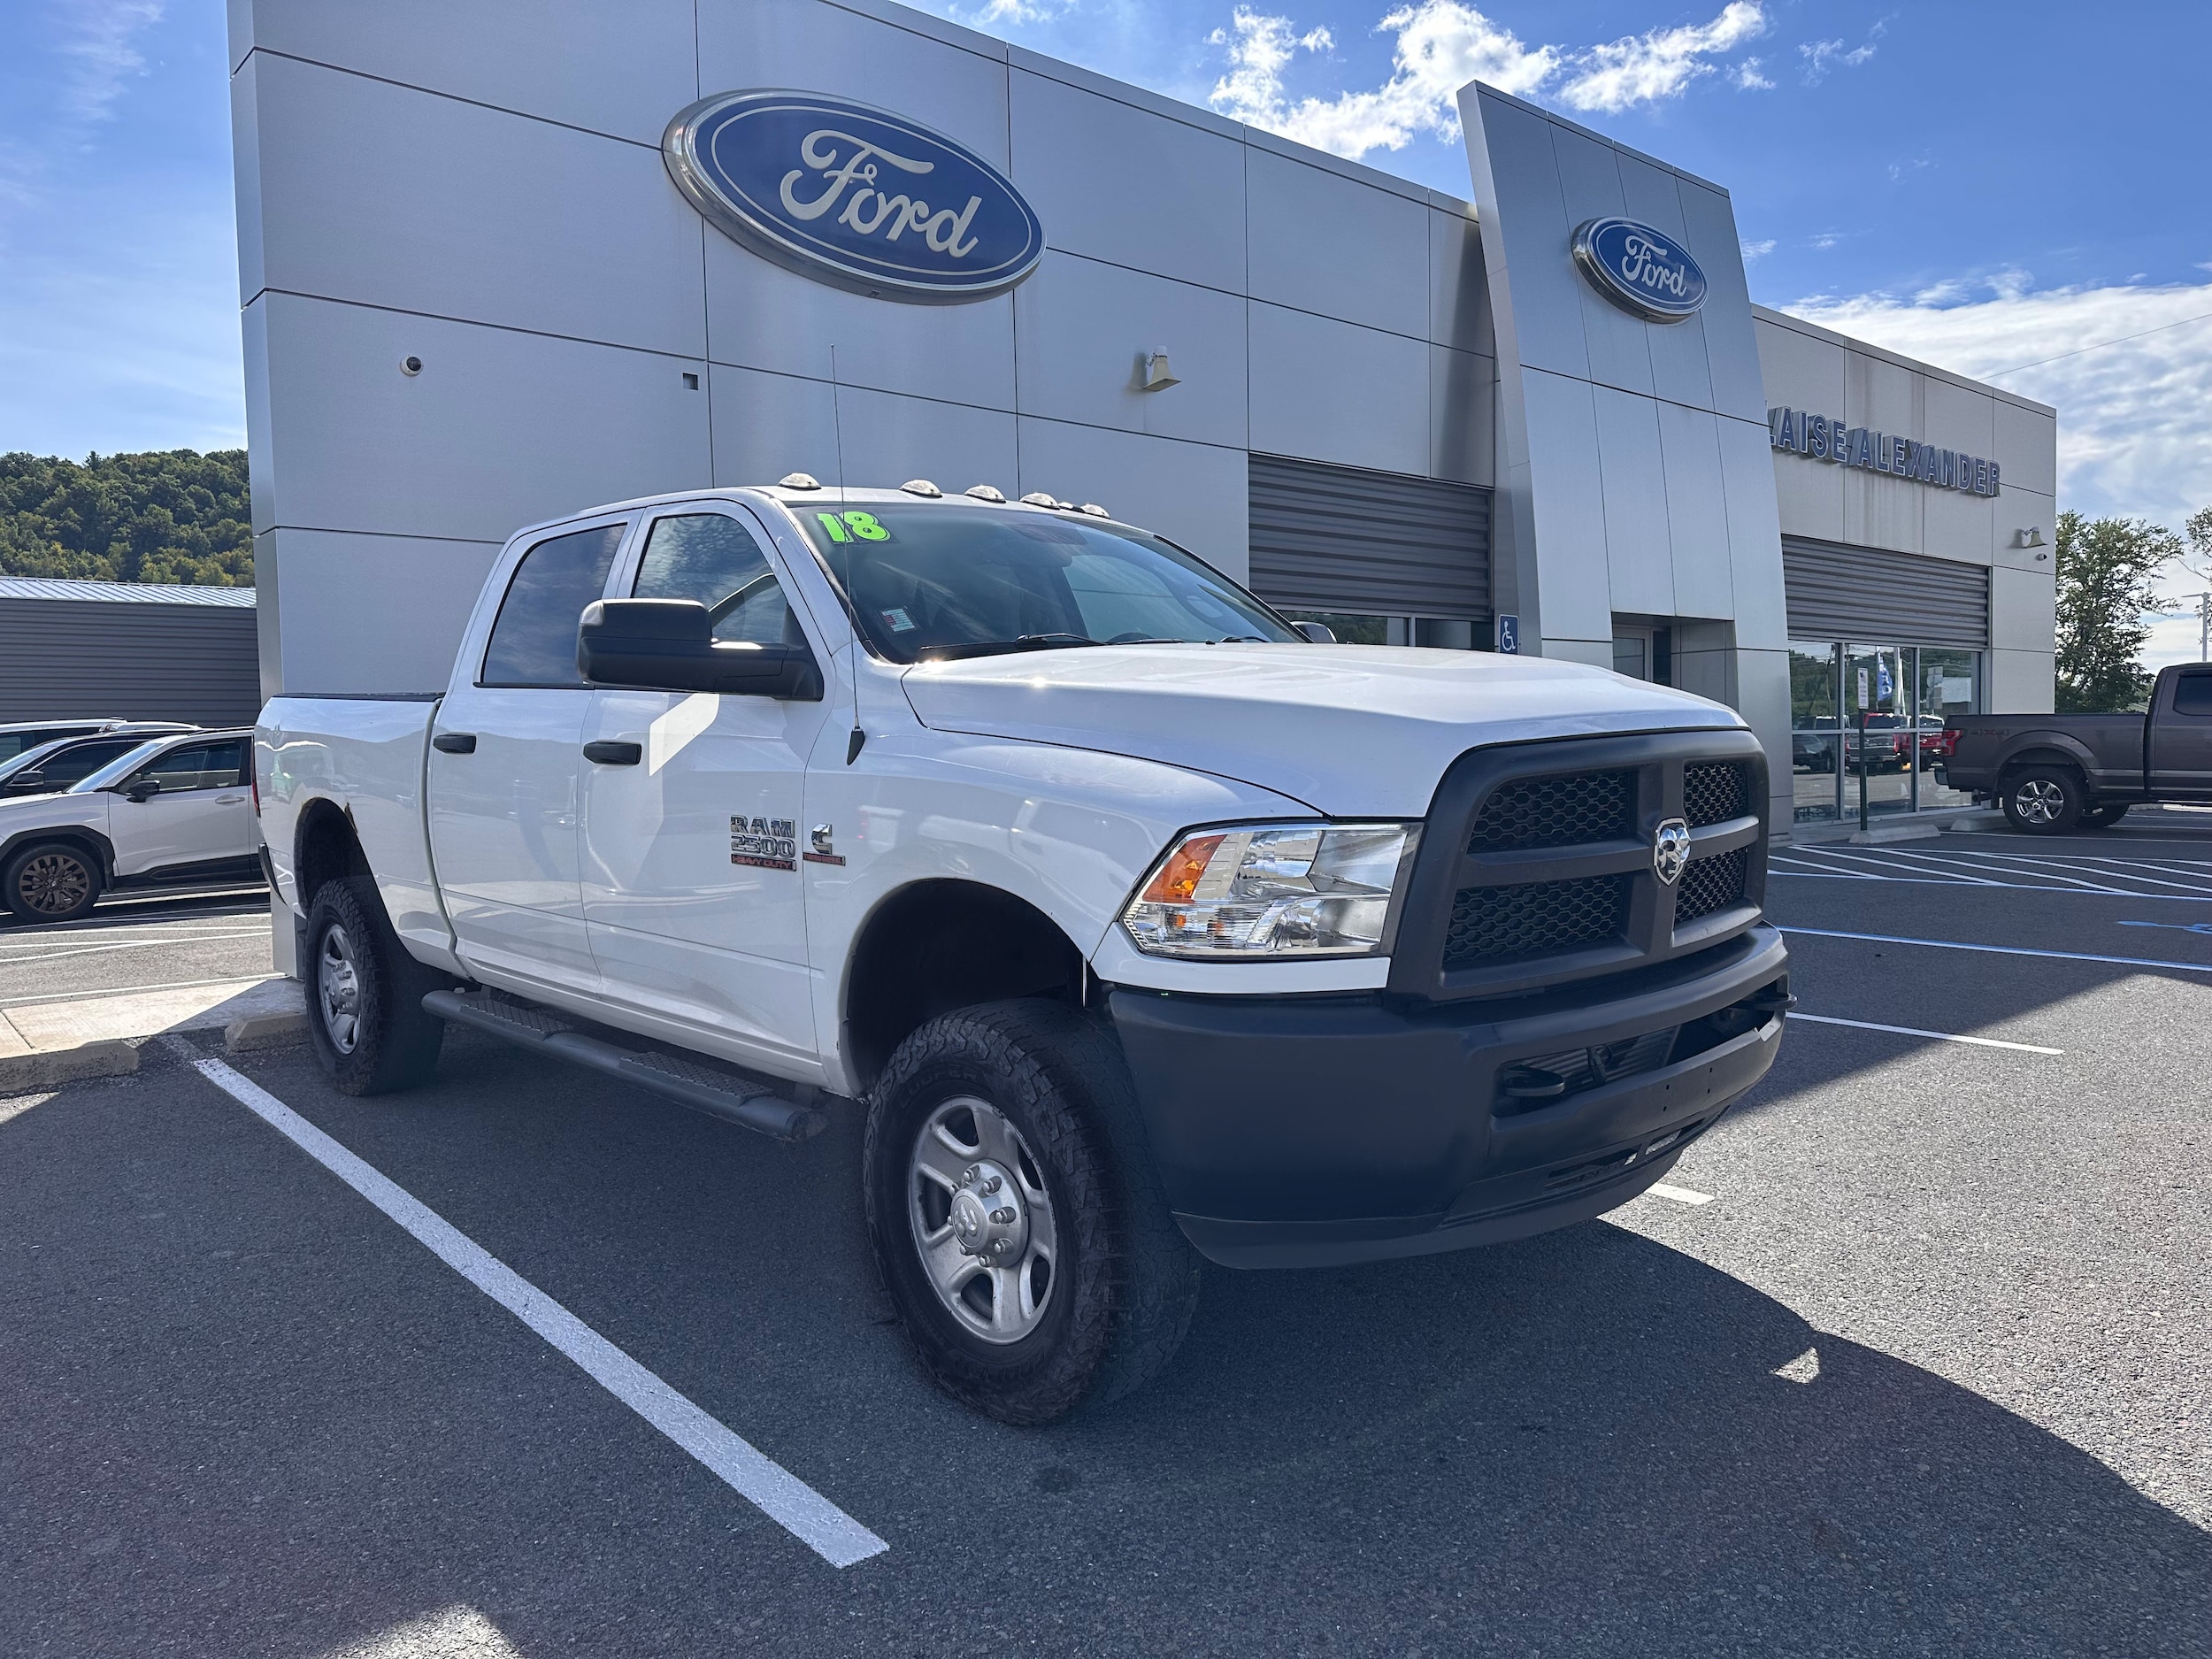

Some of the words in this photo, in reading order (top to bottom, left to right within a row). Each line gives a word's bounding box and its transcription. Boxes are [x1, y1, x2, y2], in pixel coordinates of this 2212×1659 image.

[780, 129, 982, 257] Ford
[1621, 235, 1687, 297] Ford
[1770, 406, 1847, 463] AISE
[1855, 426, 2001, 496] ALEXANDER
[817, 511, 891, 542] 18
[731, 814, 795, 838] RAM
[731, 834, 796, 858] 2500
[763, 859, 791, 869] DUTY
